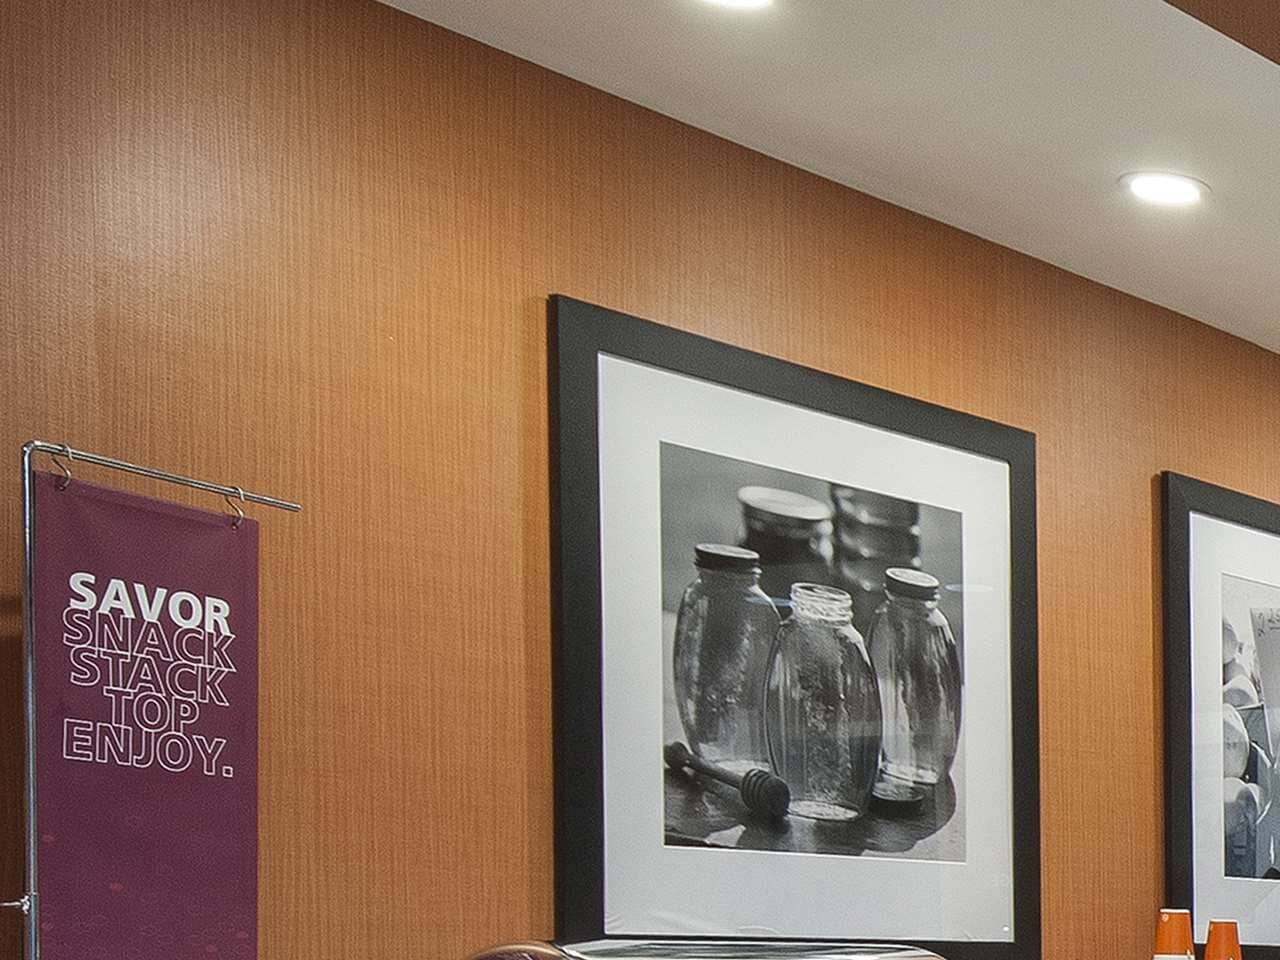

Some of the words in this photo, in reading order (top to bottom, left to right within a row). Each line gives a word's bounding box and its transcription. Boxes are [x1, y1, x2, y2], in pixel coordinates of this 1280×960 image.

[69, 572, 231, 636] SAVOR
[62, 606, 236, 672] SNACK
[70, 646, 230, 706] STACK
[104, 686, 199, 734] TOP
[62, 718, 234, 778] ENJOY.
